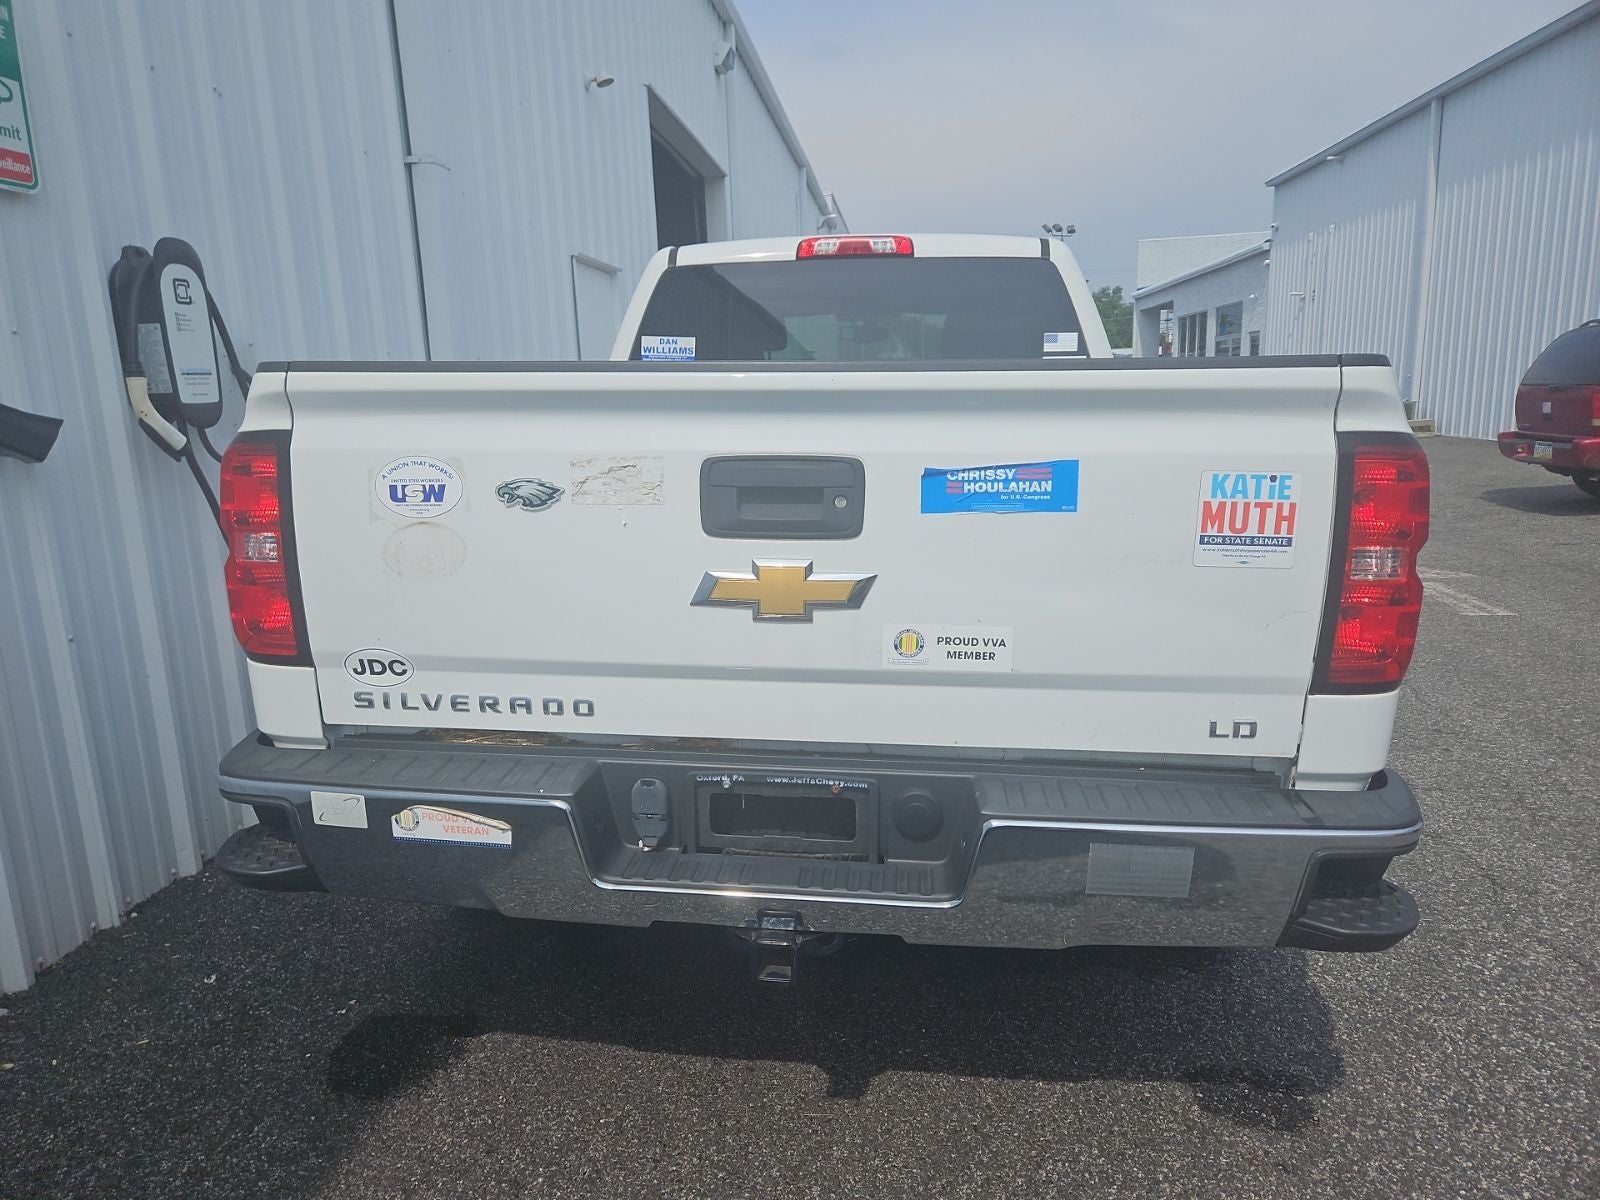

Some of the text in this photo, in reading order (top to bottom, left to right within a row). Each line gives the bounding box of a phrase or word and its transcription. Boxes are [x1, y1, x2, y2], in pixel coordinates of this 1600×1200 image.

[643, 346, 694, 355] WILLIAMS
[386, 461, 409, 475] UNION
[428, 463, 454, 480] WORKS!
[946, 468, 1017, 481] CHRISSY
[963, 480, 1052, 493] HOULAHAN
[389, 484, 446, 503] USW
[1200, 501, 1297, 536] MUTH
[1204, 536, 1289, 546] FOR STATE SENATE
[936, 636, 1007, 648] PROUD VVA
[946, 650, 996, 661] MEMBER
[352, 659, 408, 677] JDC
[353, 691, 595, 718] SILVERADO
[1209, 720, 1258, 739] LD
[732, 774, 745, 782] PA
[766, 776, 868, 788] www.JeffsChevy.com
[421, 812, 459, 823] PROUD
[443, 824, 490, 836] VETERAN
